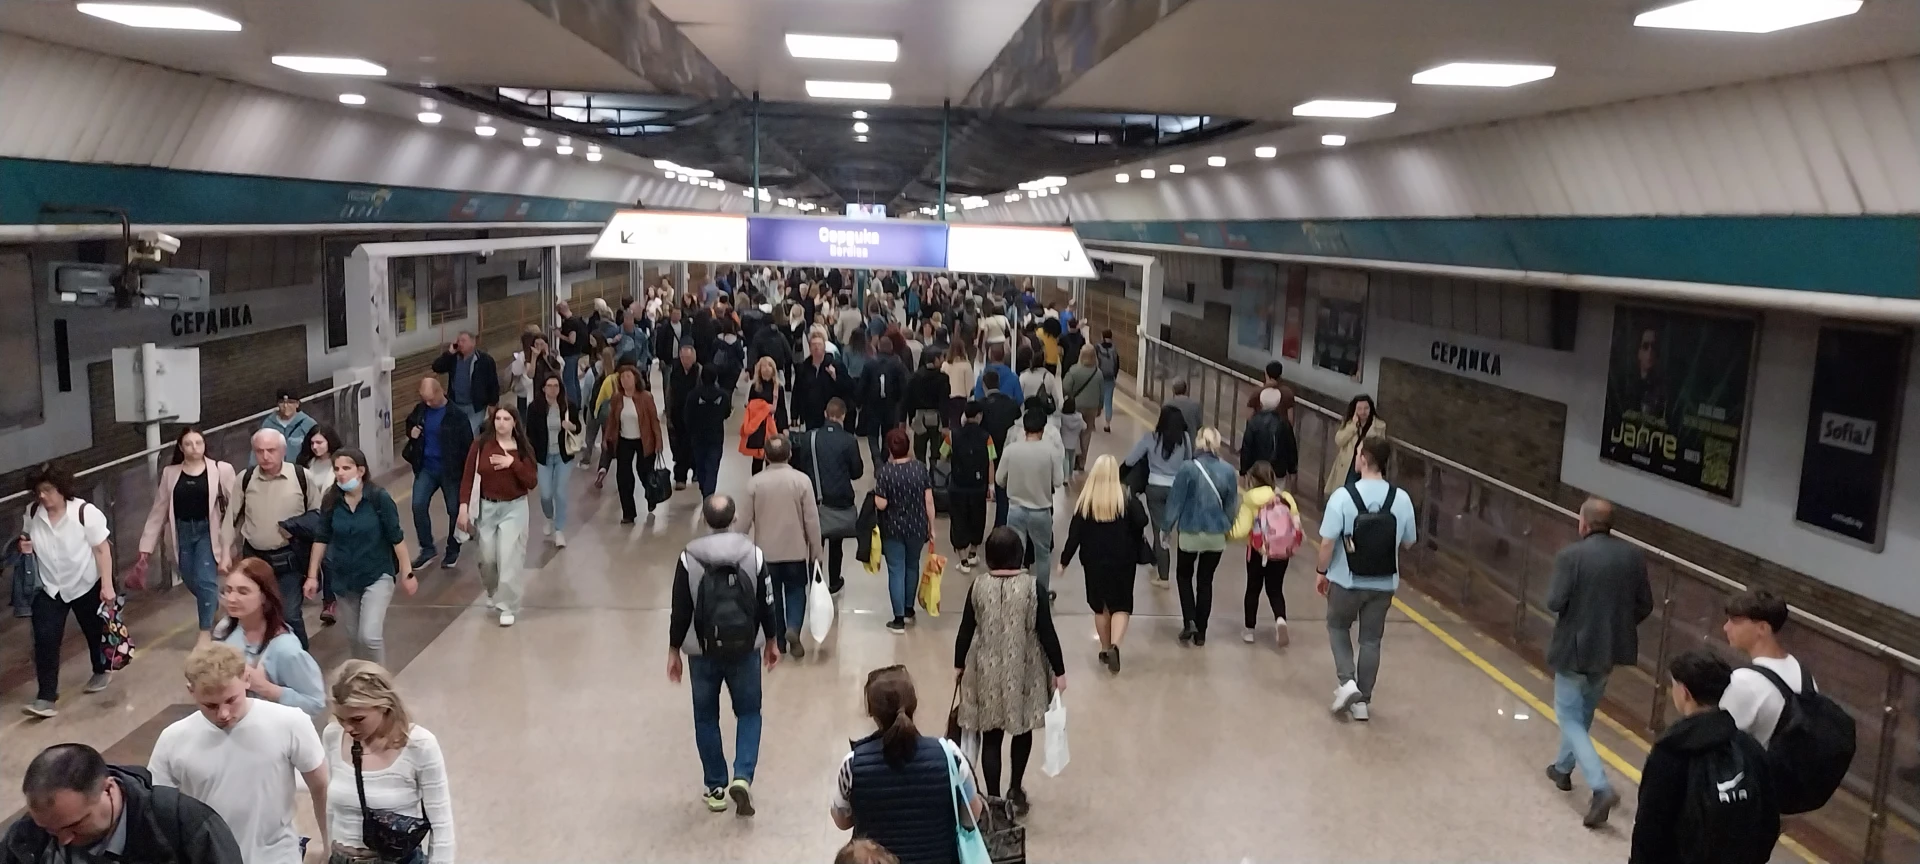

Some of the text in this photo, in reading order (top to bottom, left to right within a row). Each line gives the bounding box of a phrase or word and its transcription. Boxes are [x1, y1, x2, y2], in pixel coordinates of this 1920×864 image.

[171, 304, 253, 337] СЕРДИКА
[1430, 341, 1502, 376] СЕРДИКА
[1823, 419, 1872, 446] Sofia!
